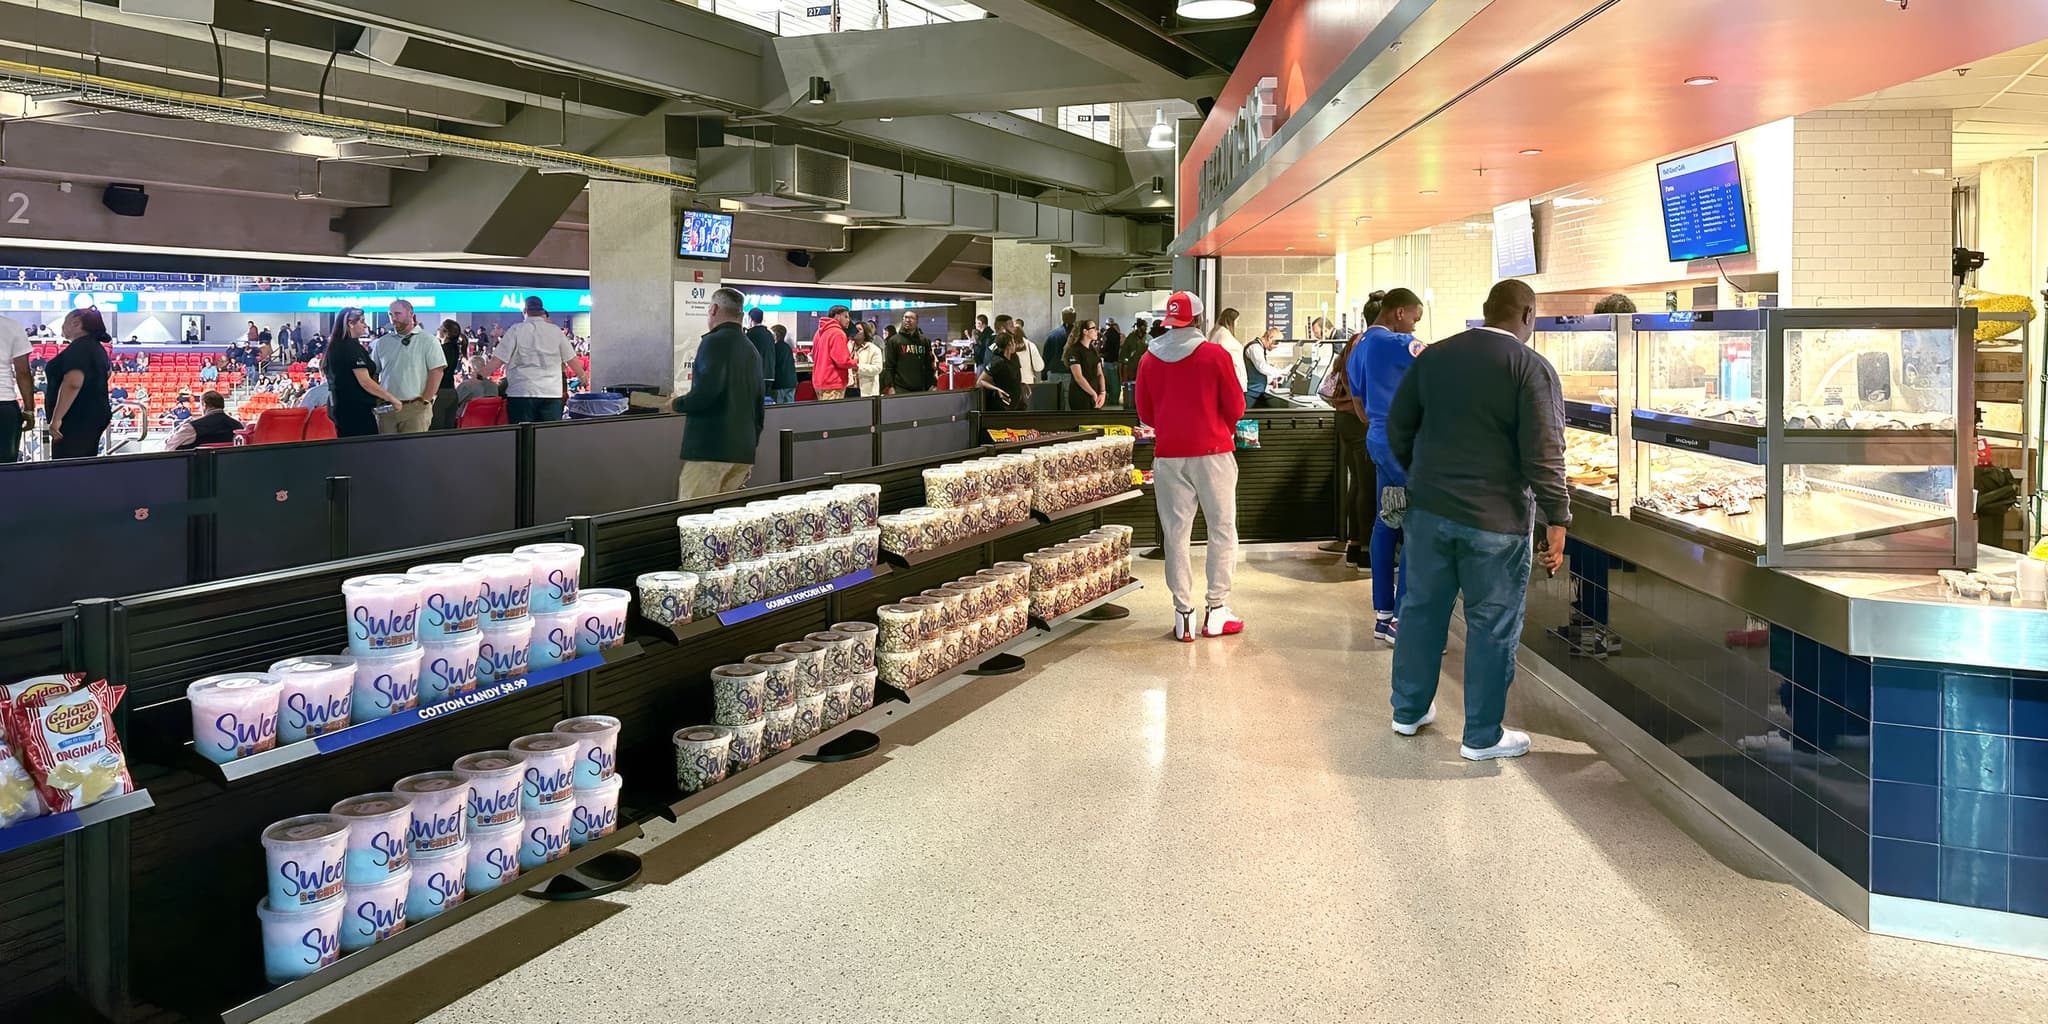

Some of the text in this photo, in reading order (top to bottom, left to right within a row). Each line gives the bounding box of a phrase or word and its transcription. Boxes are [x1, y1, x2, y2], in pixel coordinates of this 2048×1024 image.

[808, 7, 820, 16] 217
[744, 254, 765, 273] 113
[427, 593, 479, 627] Swe
[478, 579, 532, 614] Sweet
[354, 603, 420, 641] Sweet
[585, 616, 626, 647] Swe
[431, 658, 478, 691] Swe
[373, 674, 418, 709] Swe
[418, 678, 528, 719] COTTON CANDY $8.99
[48, 701, 95, 725] Golden
[57, 710, 96, 734] Flake
[56, 740, 106, 762] ORIGINAL
[467, 781, 523, 819] Sweet
[531, 824, 571, 857] Swe
[358, 898, 407, 936] Swe
